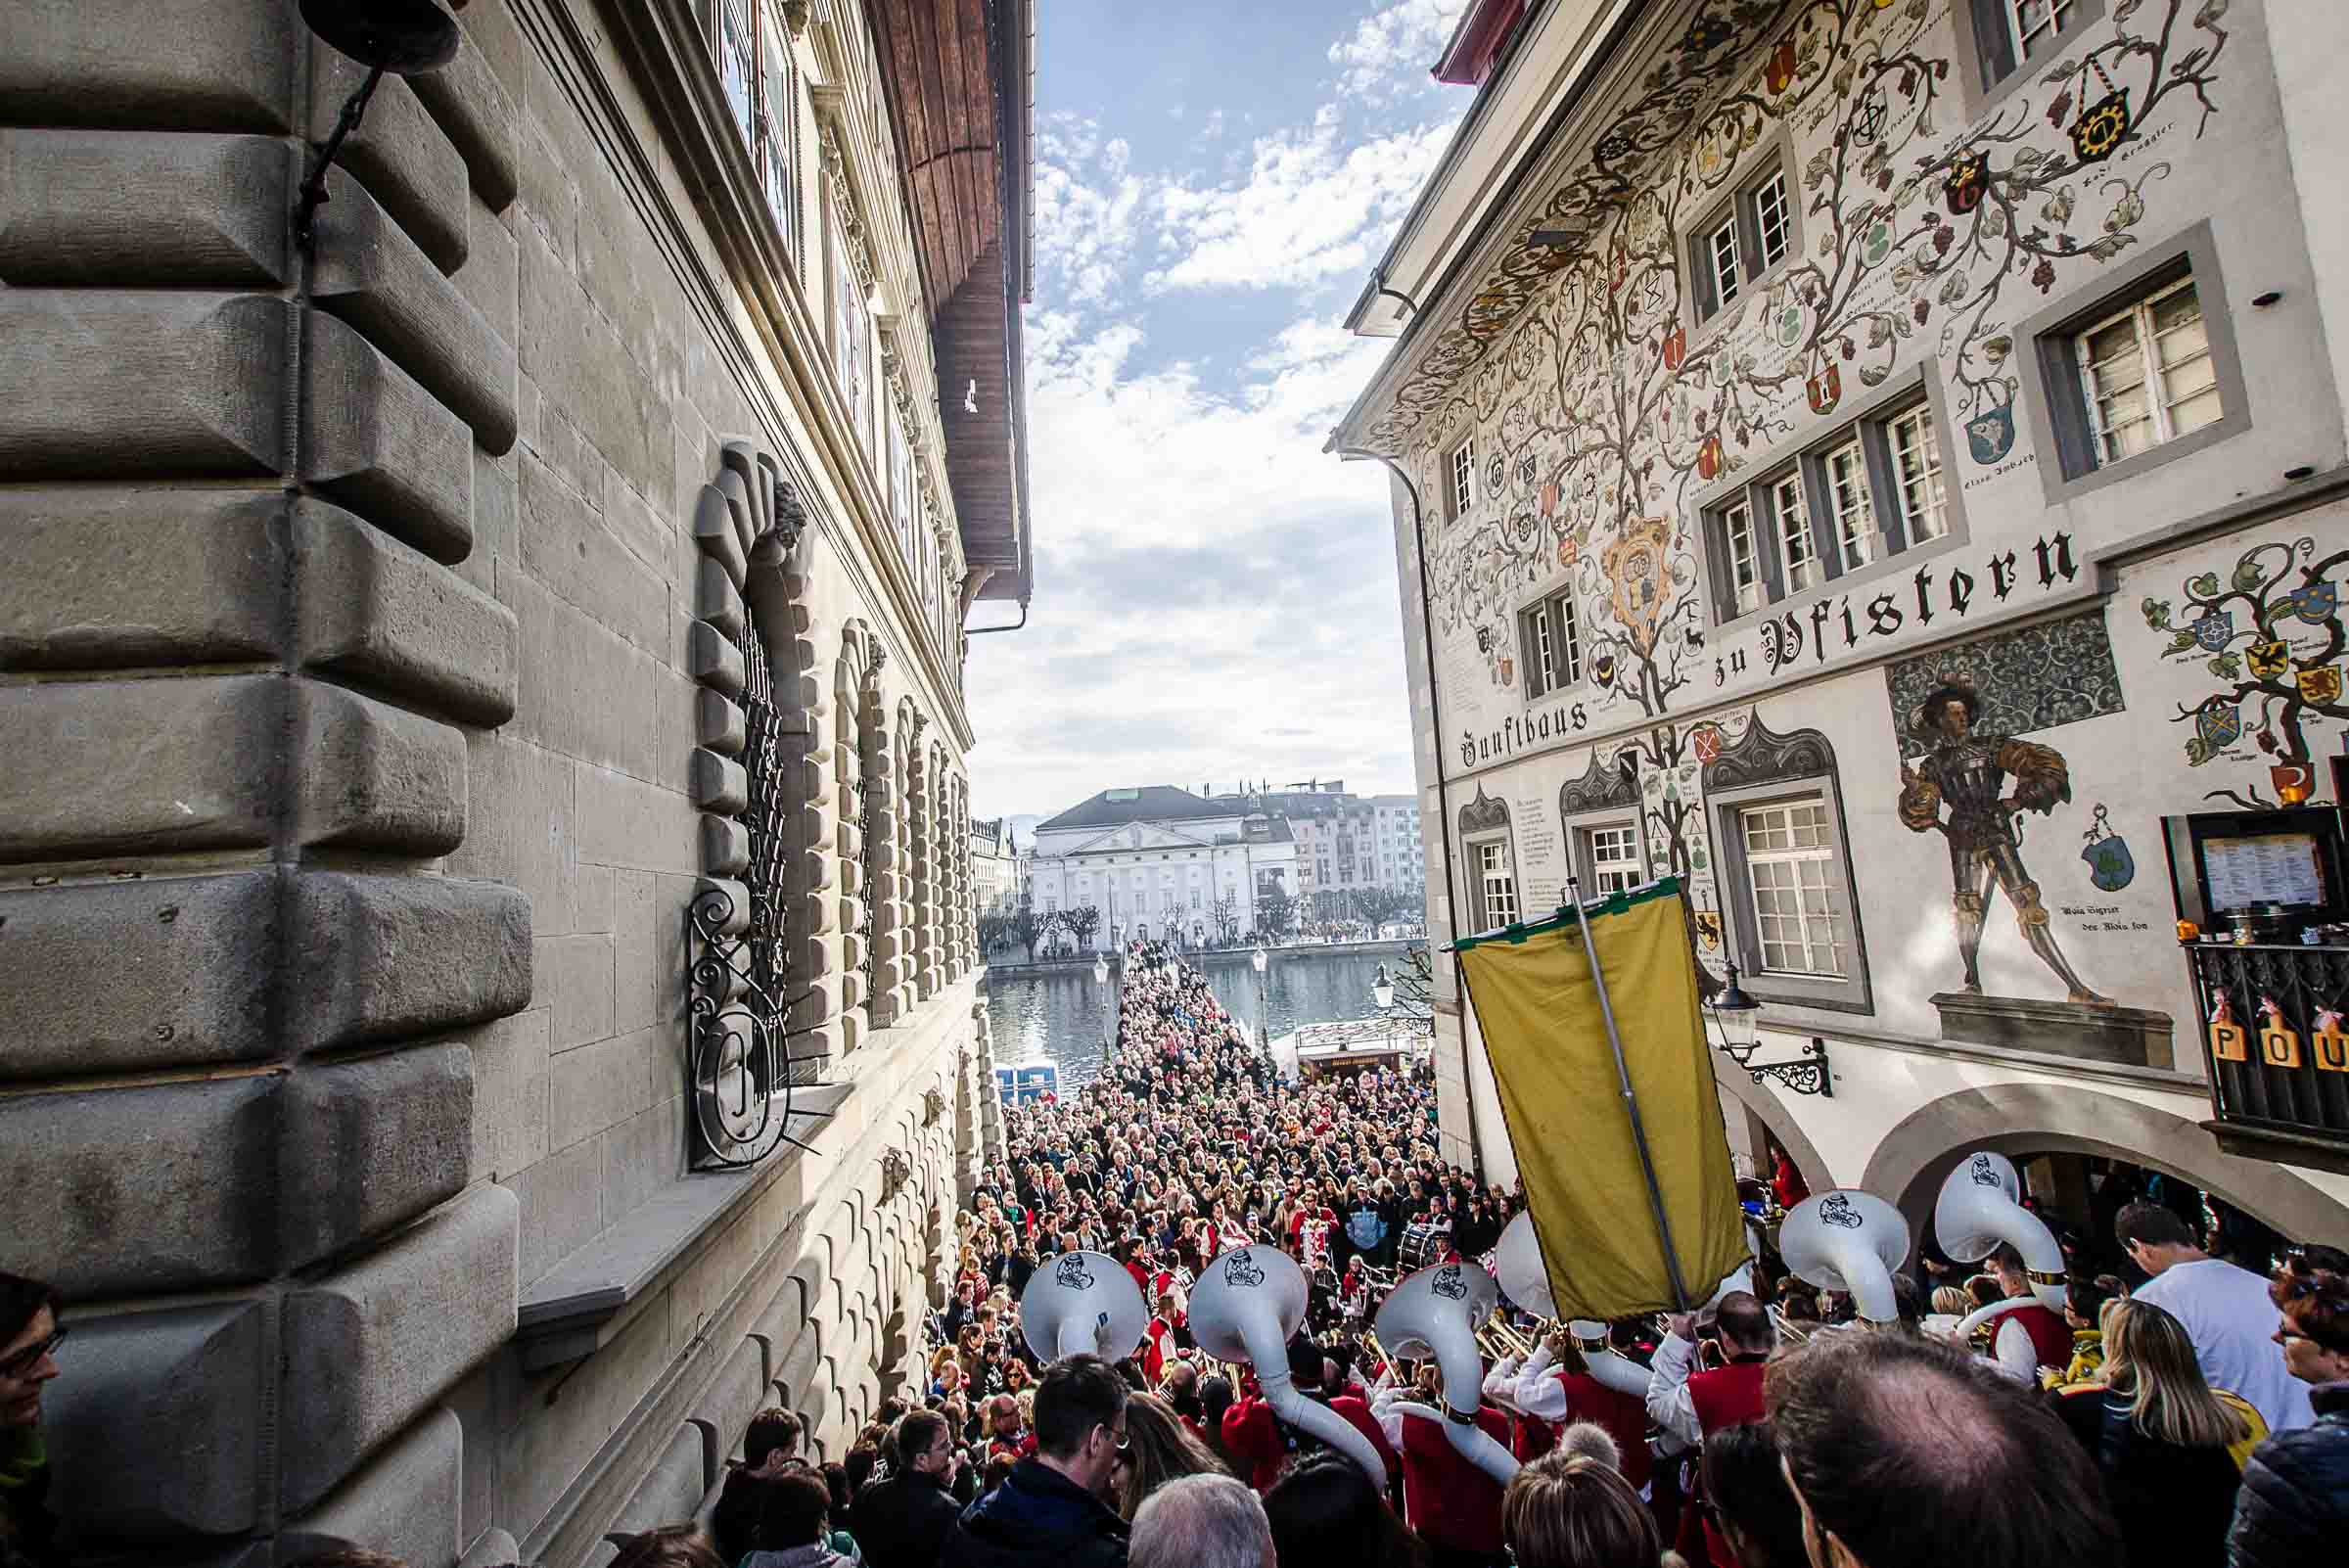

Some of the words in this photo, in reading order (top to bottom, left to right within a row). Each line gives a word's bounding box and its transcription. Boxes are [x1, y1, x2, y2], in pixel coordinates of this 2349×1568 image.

[1460, 701, 1588, 767] Zunfthaus
[1715, 647, 1746, 687] zu
[1761, 530, 2079, 675] Pfistern
